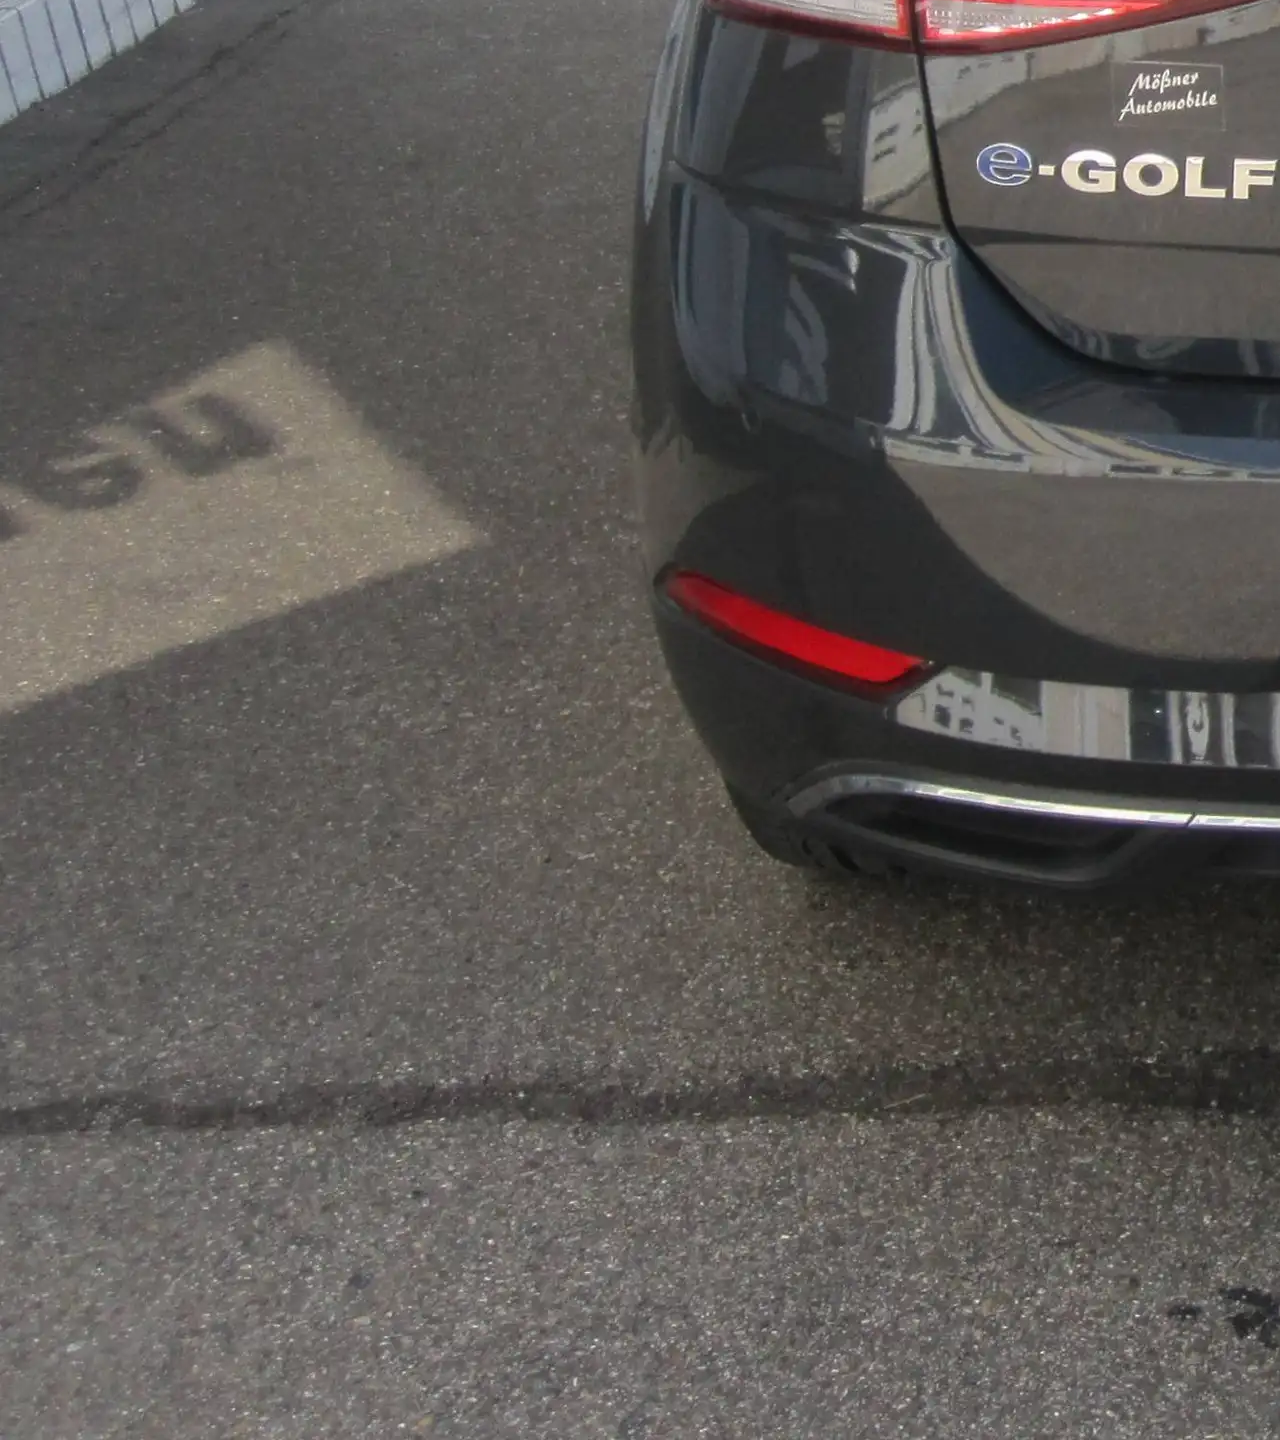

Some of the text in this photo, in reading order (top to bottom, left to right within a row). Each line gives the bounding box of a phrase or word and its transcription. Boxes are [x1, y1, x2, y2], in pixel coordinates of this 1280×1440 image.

[1128, 68, 1200, 96] Mößner
[1118, 90, 1218, 121] Automobile
[976, 143, 1279, 200] e-GOLF
